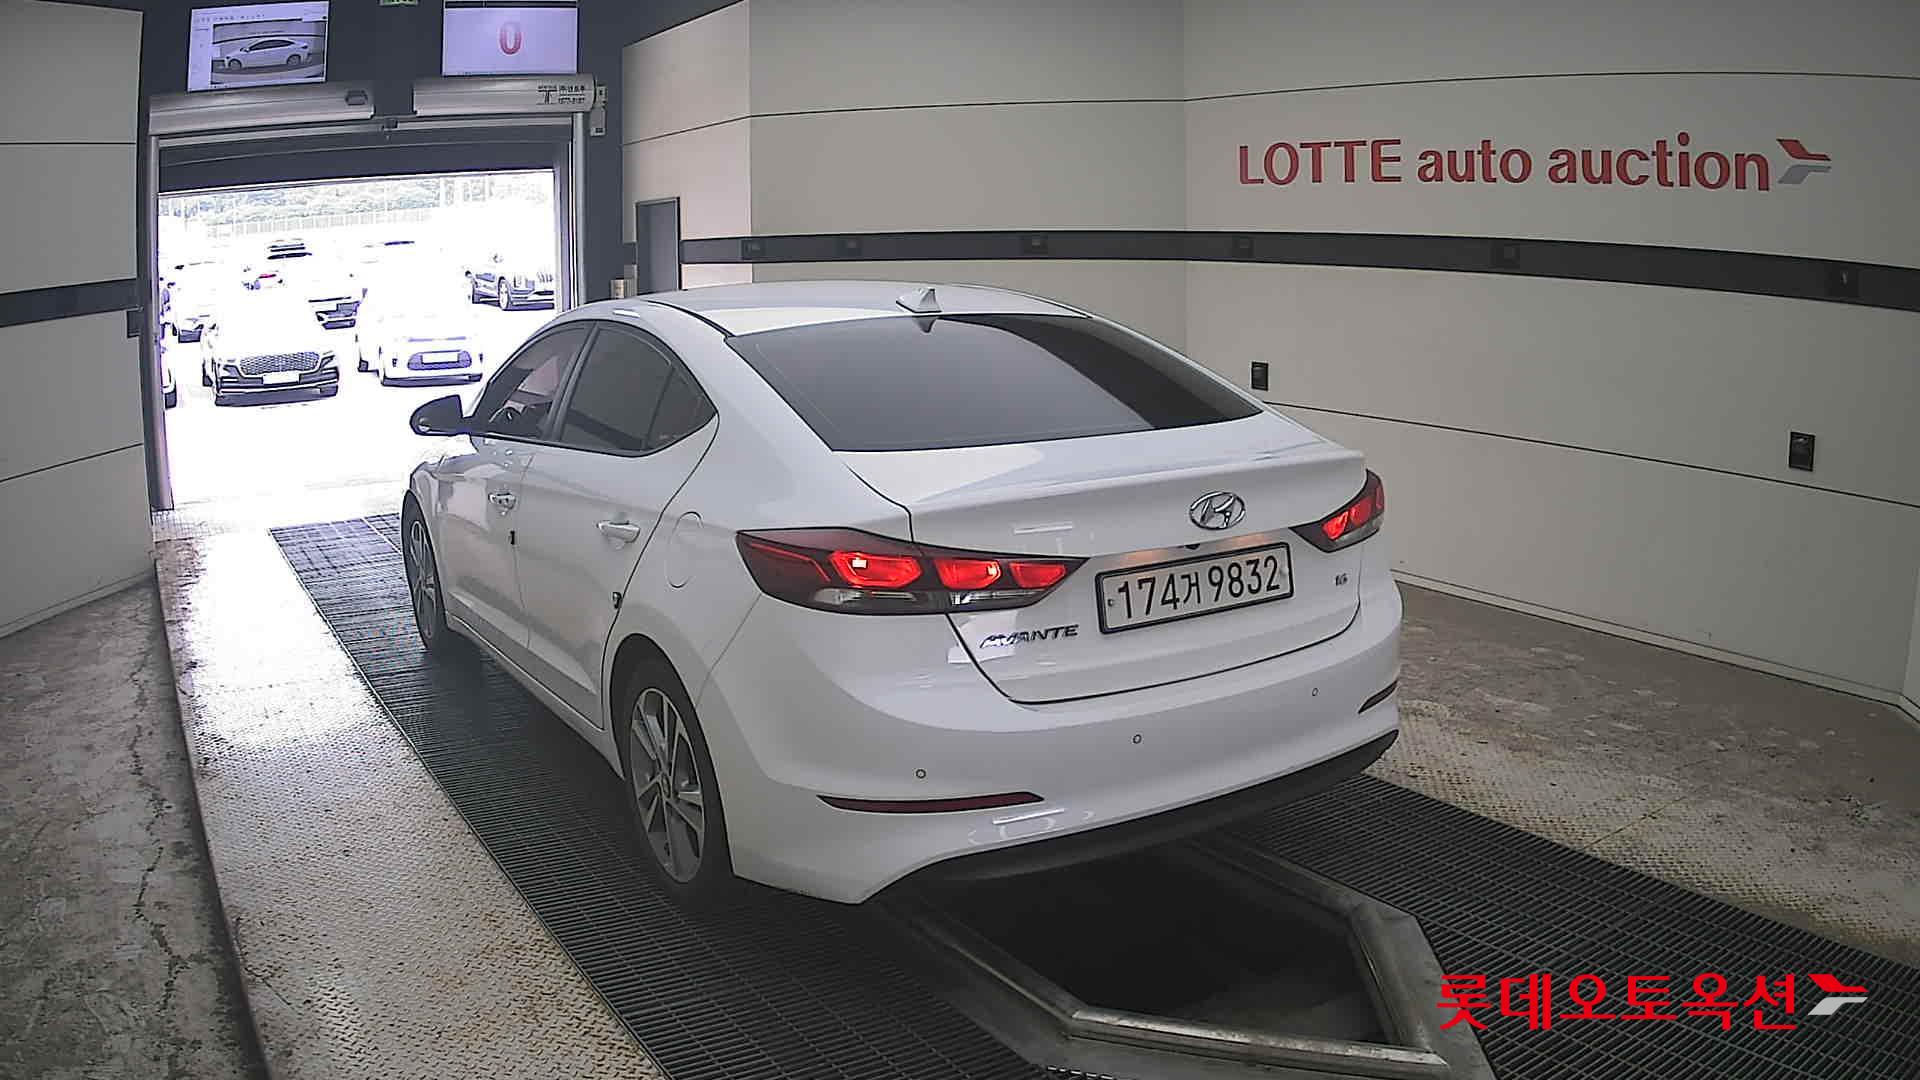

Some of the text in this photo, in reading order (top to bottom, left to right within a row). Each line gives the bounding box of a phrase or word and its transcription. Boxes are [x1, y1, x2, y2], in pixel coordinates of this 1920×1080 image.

[1239, 132, 1769, 192] LOTTE auto auction
[1207, 555, 1281, 602] 9832
[979, 624, 1079, 649] AVANTE
